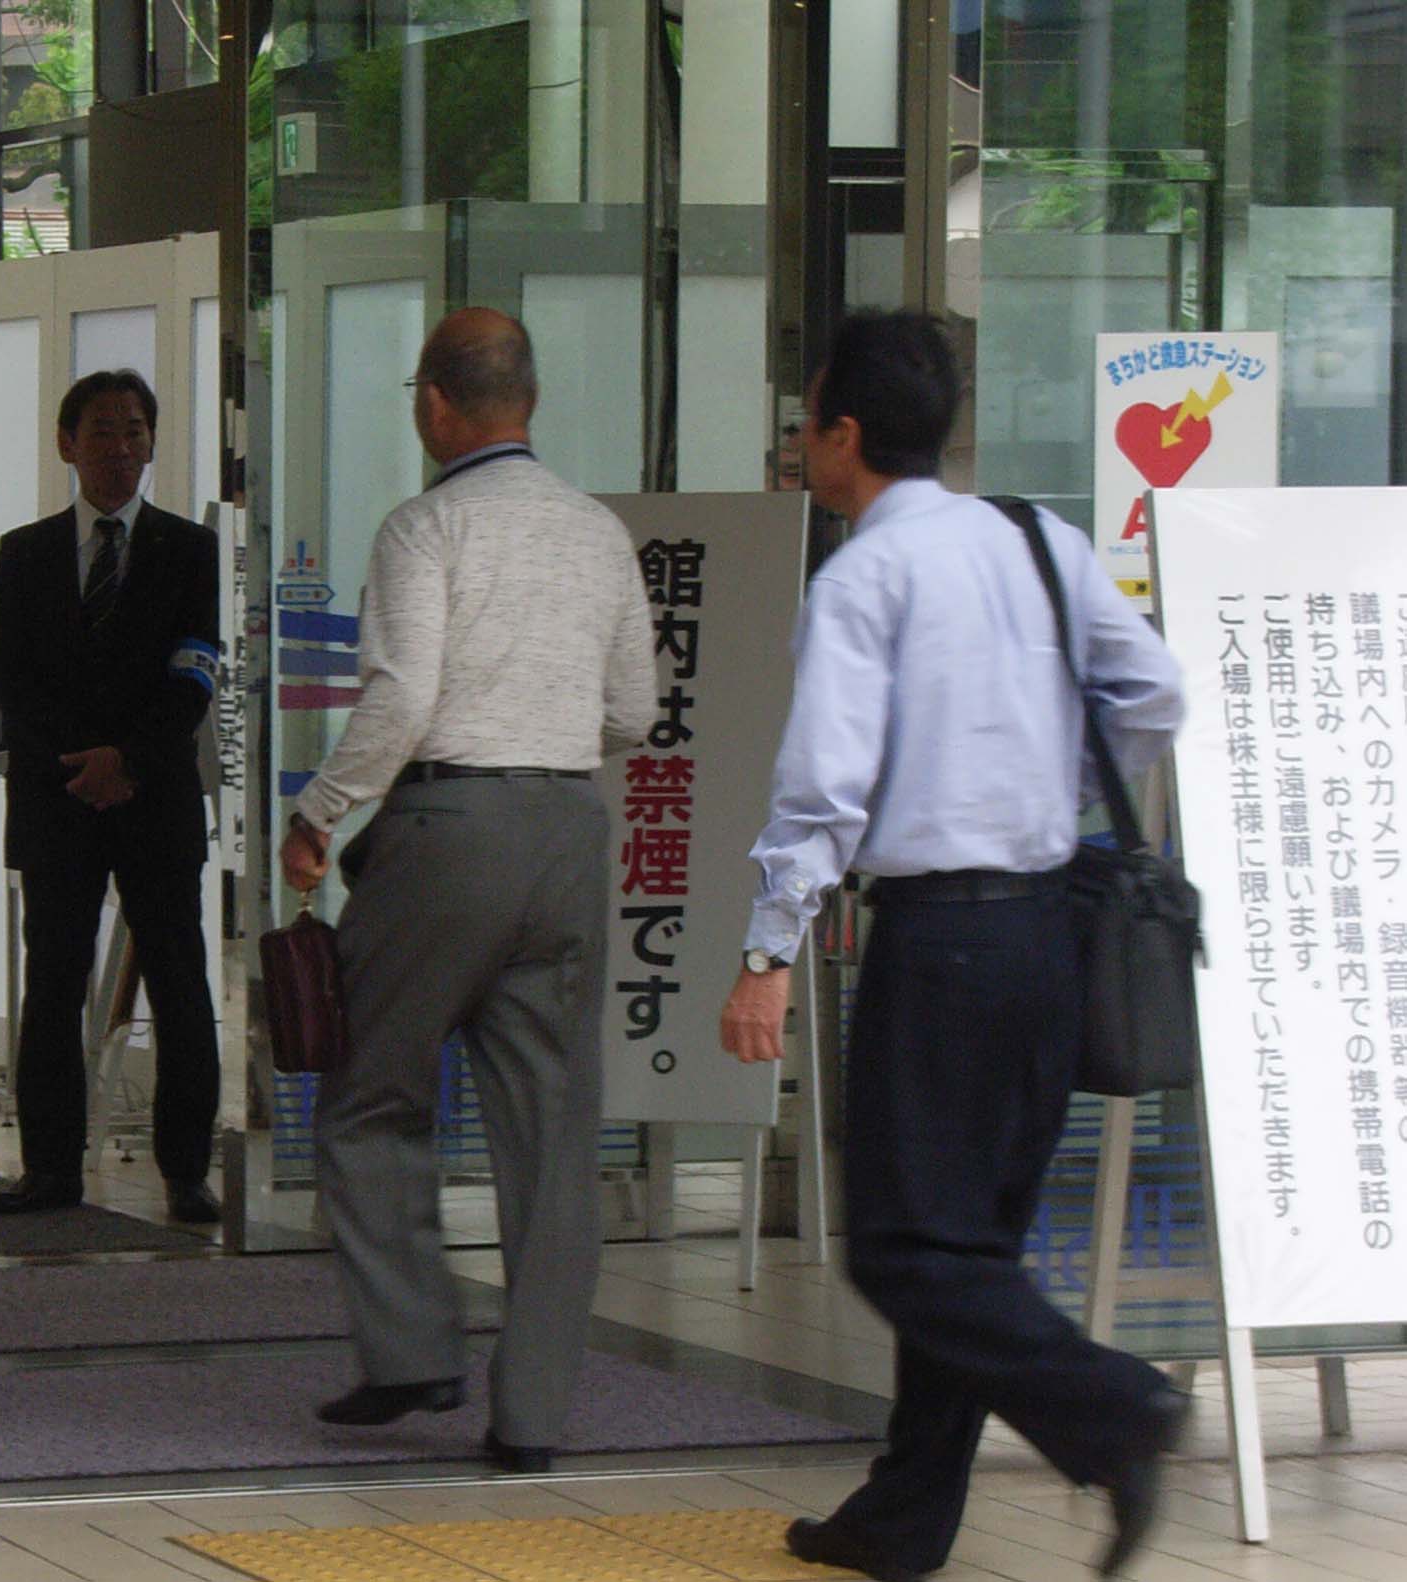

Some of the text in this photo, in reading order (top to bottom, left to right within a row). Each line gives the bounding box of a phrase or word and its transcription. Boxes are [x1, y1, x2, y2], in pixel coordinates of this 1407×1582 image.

[1105, 340, 1267, 386] まちかど救急ステーション
[1218, 594, 1301, 1237] ご入場は株主様に限らせていただきます。
[1262, 594, 1322, 990] ご使用はご遠慮願います。
[1303, 592, 1393, 1250] 持ち込み、および議場内での携帯電話の
